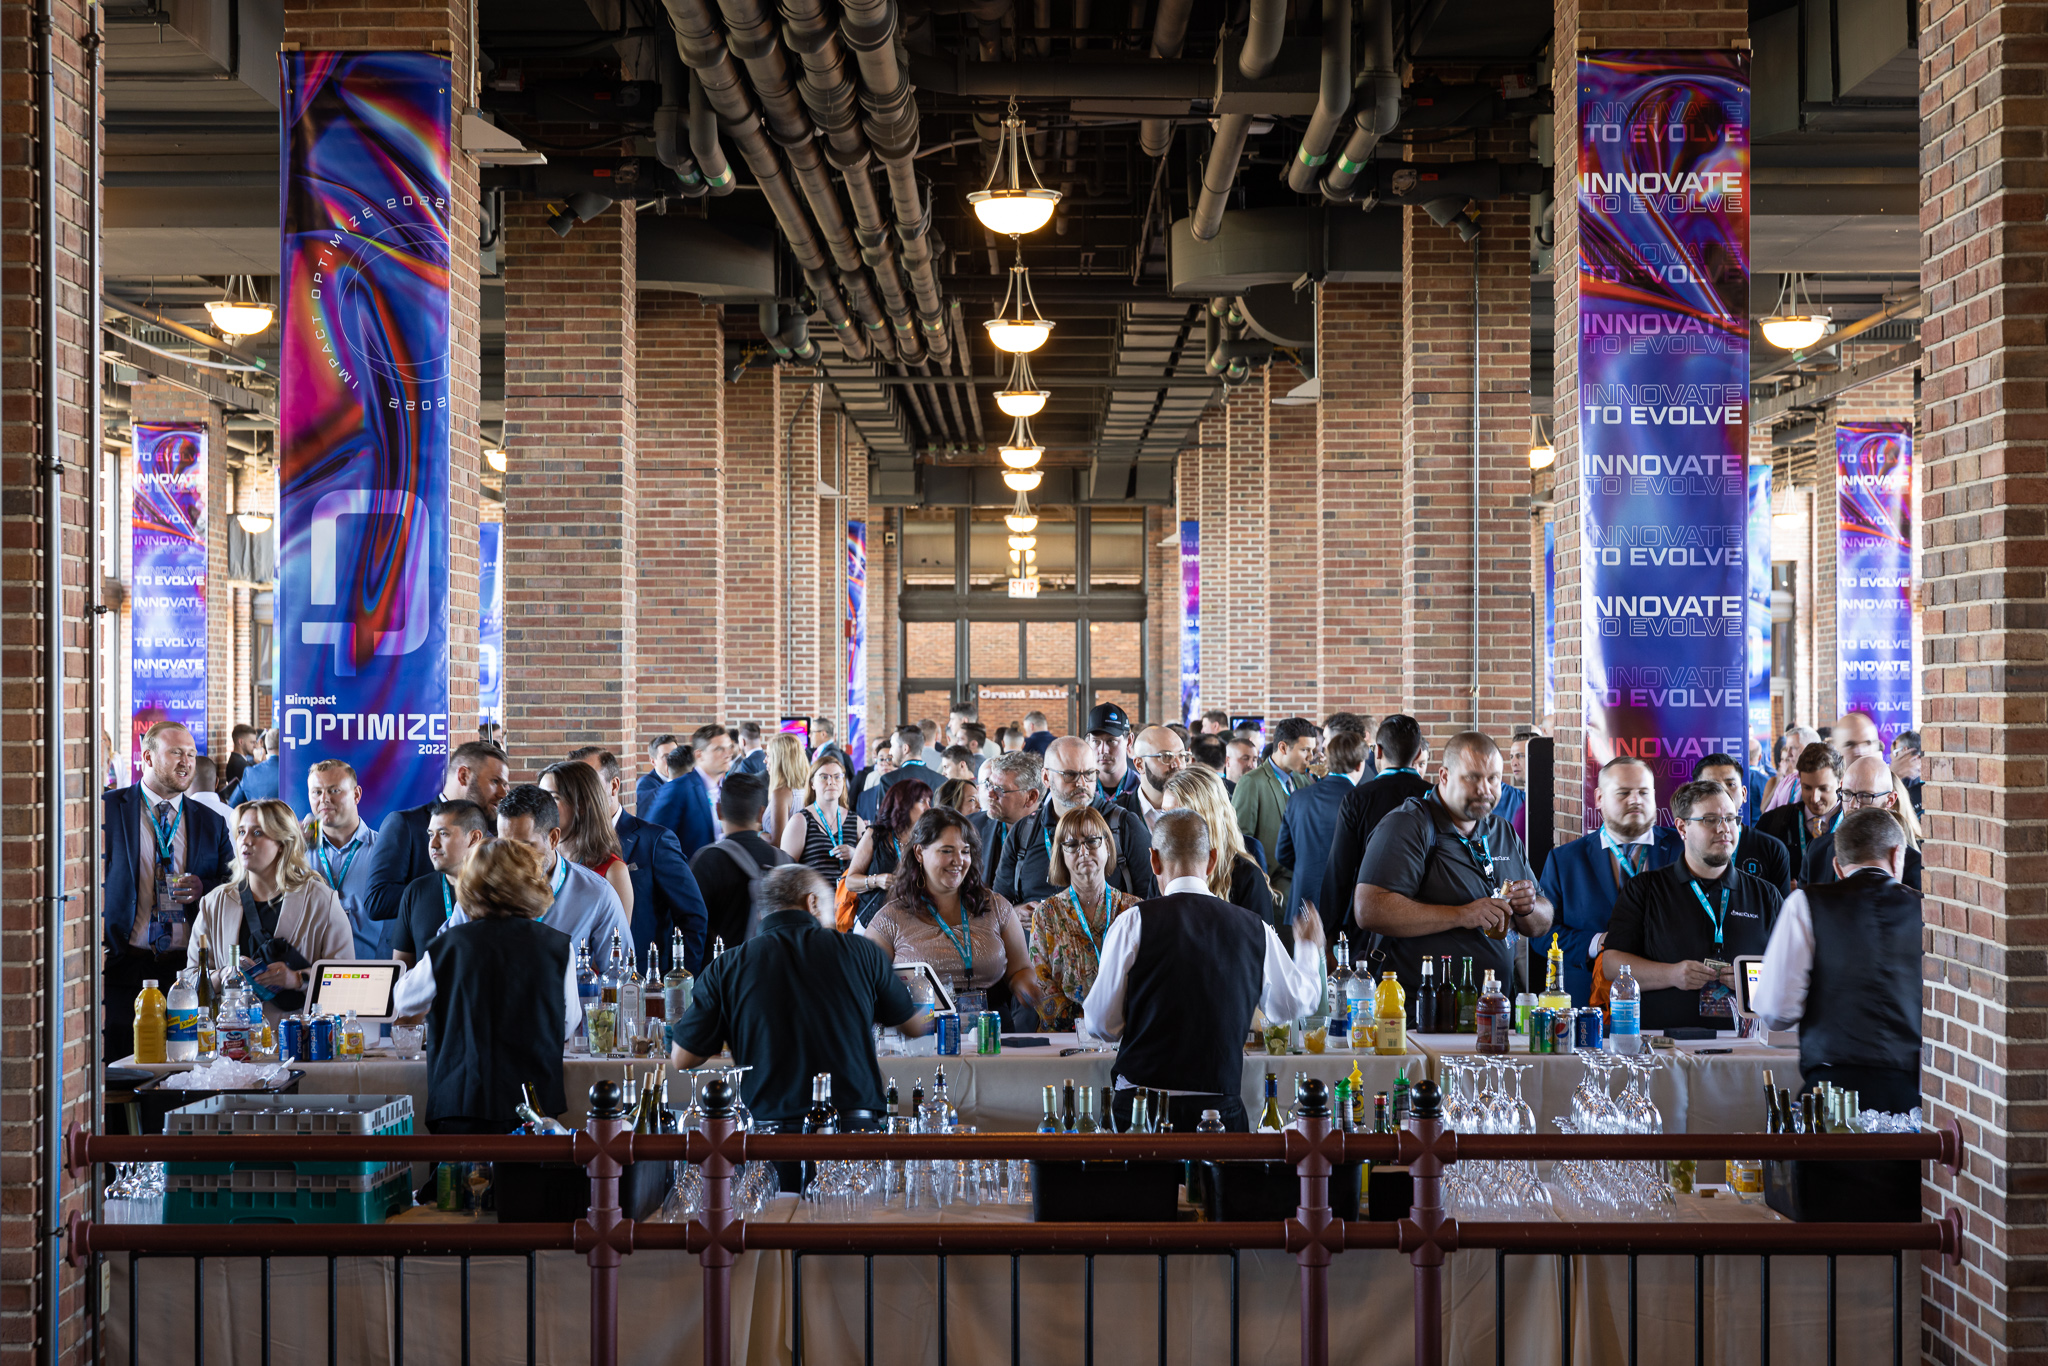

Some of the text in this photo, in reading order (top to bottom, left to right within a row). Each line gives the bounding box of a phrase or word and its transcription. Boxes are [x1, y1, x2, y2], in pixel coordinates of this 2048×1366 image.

[1583, 101, 1742, 123] INNOVATE
[1583, 124, 1742, 143] TO EVOLVE
[1583, 172, 1742, 193] INNOVATE
[1583, 194, 1742, 214] TO EVOLVE
[1583, 314, 1742, 334] INNOVATE
[1583, 335, 1742, 354] TO EVOLVE
[1583, 384, 1742, 405] INNOVATE
[1584, 406, 1742, 425] TO EVOLVE
[1584, 454, 1742, 476] INNOVATE
[136, 473, 205, 484] INNOVATE
[1584, 476, 1742, 496] TO EVOLVE
[1839, 475, 1910, 486] INNOVATE
[1630, 548, 1742, 566] EVOLVE
[134, 576, 205, 586] TO EVOLVE
[1840, 578, 1910, 588] TO EVOLVE
[134, 597, 205, 608] INNOVATE
[1592, 596, 1742, 616] NNOVATE
[1839, 598, 1910, 610] INNOVATE
[1629, 618, 1742, 637] EVOLVE
[134, 638, 204, 648] TO EVOLVE
[1840, 640, 1910, 649] TO EVOLVE
[133, 658, 204, 670] INNOVATE
[1839, 660, 1910, 672] INNOVATE
[294, 693, 336, 707] impact
[979, 689, 1026, 700] Grand
[1630, 688, 1742, 708] EVOLVE
[134, 700, 204, 710] TO EVOLVE
[1860, 702, 1911, 711] EVOLVE
[418, 744, 446, 755] 2022
[310, 1028, 318, 1054] pepsi
